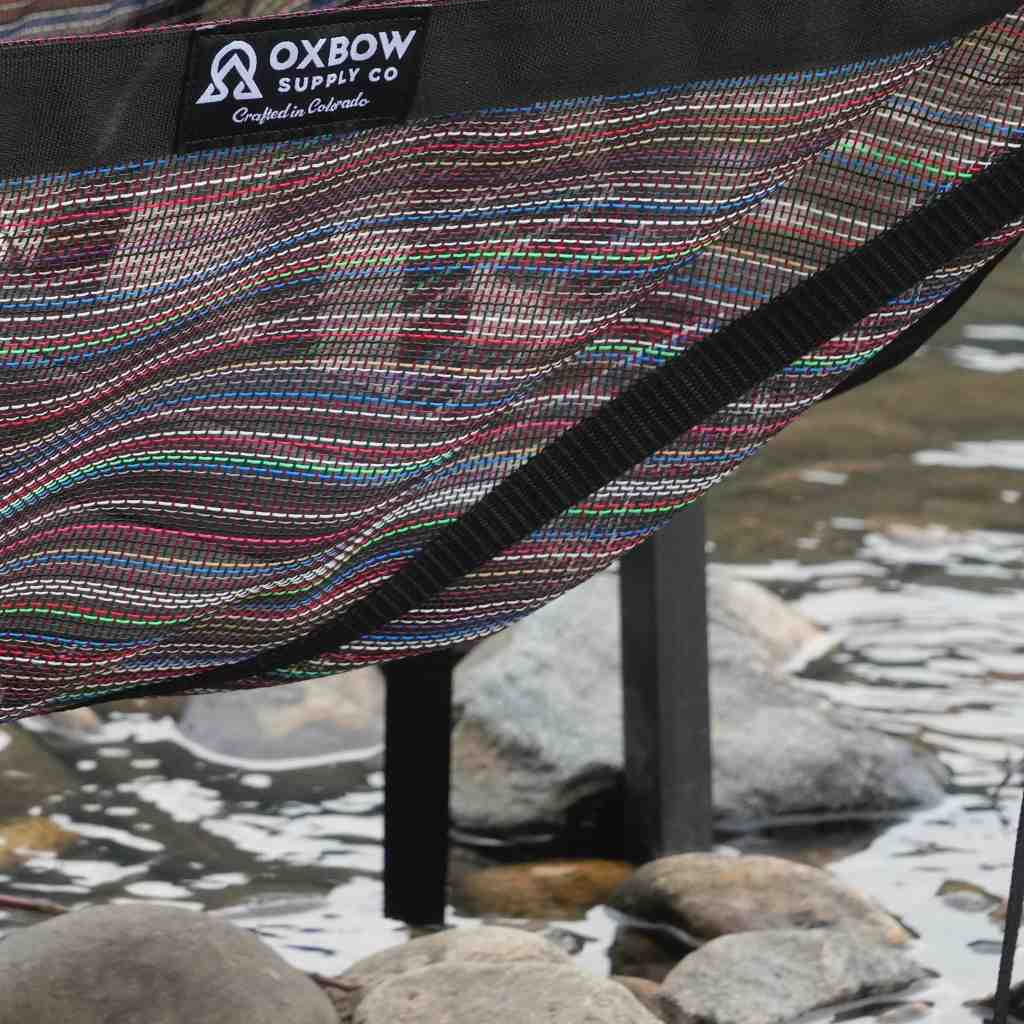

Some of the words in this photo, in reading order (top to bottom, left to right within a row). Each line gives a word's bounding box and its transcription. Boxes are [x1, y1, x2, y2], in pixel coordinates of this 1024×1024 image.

[269, 30, 417, 71] OXBOW
[277, 67, 360, 93] SUPPLY
[368, 67, 398, 82] CO
[232, 103, 291, 125] Crafted
[290, 104, 305, 119] in
[307, 92, 370, 115] Colorado
